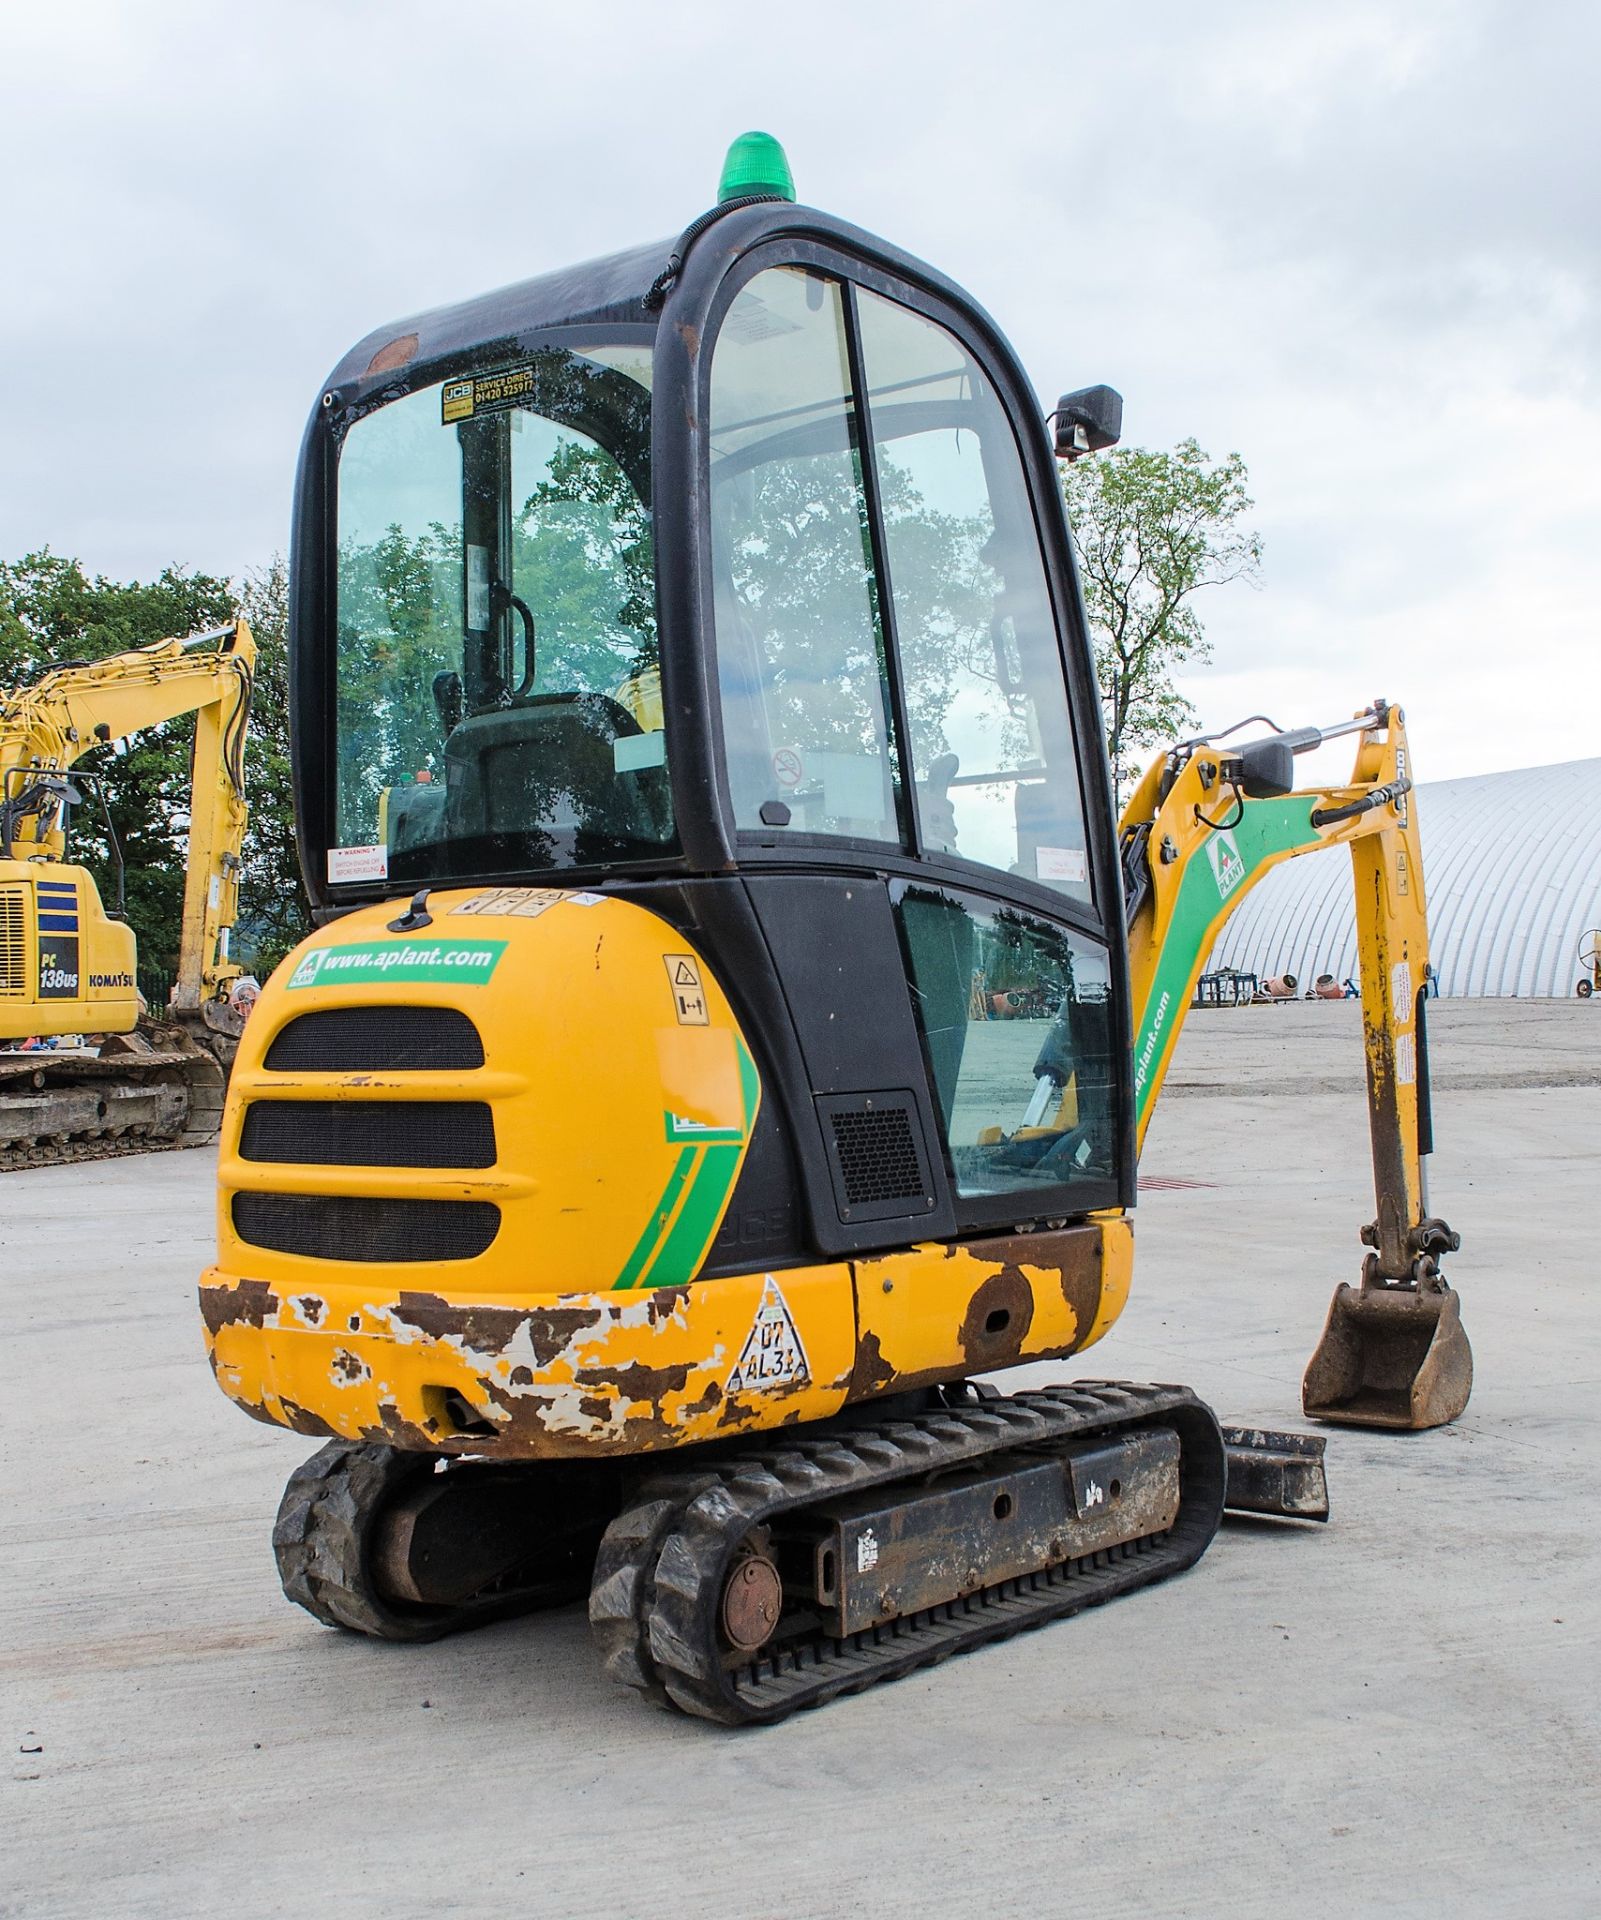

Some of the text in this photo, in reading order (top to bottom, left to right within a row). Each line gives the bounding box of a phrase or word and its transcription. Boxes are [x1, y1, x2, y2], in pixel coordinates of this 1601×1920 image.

[475, 379, 505, 392] SERVICE
[506, 370, 533, 385] DIRECT
[446, 384, 471, 400] JCB
[475, 380, 533, 403] 01420 525917
[1220, 862, 1242, 895] PLANT
[41, 953, 57, 968] PC
[324, 947, 492, 971] www.aplant.com
[89, 971, 134, 987] KOMATSU
[292, 974, 315, 984] PLANT
